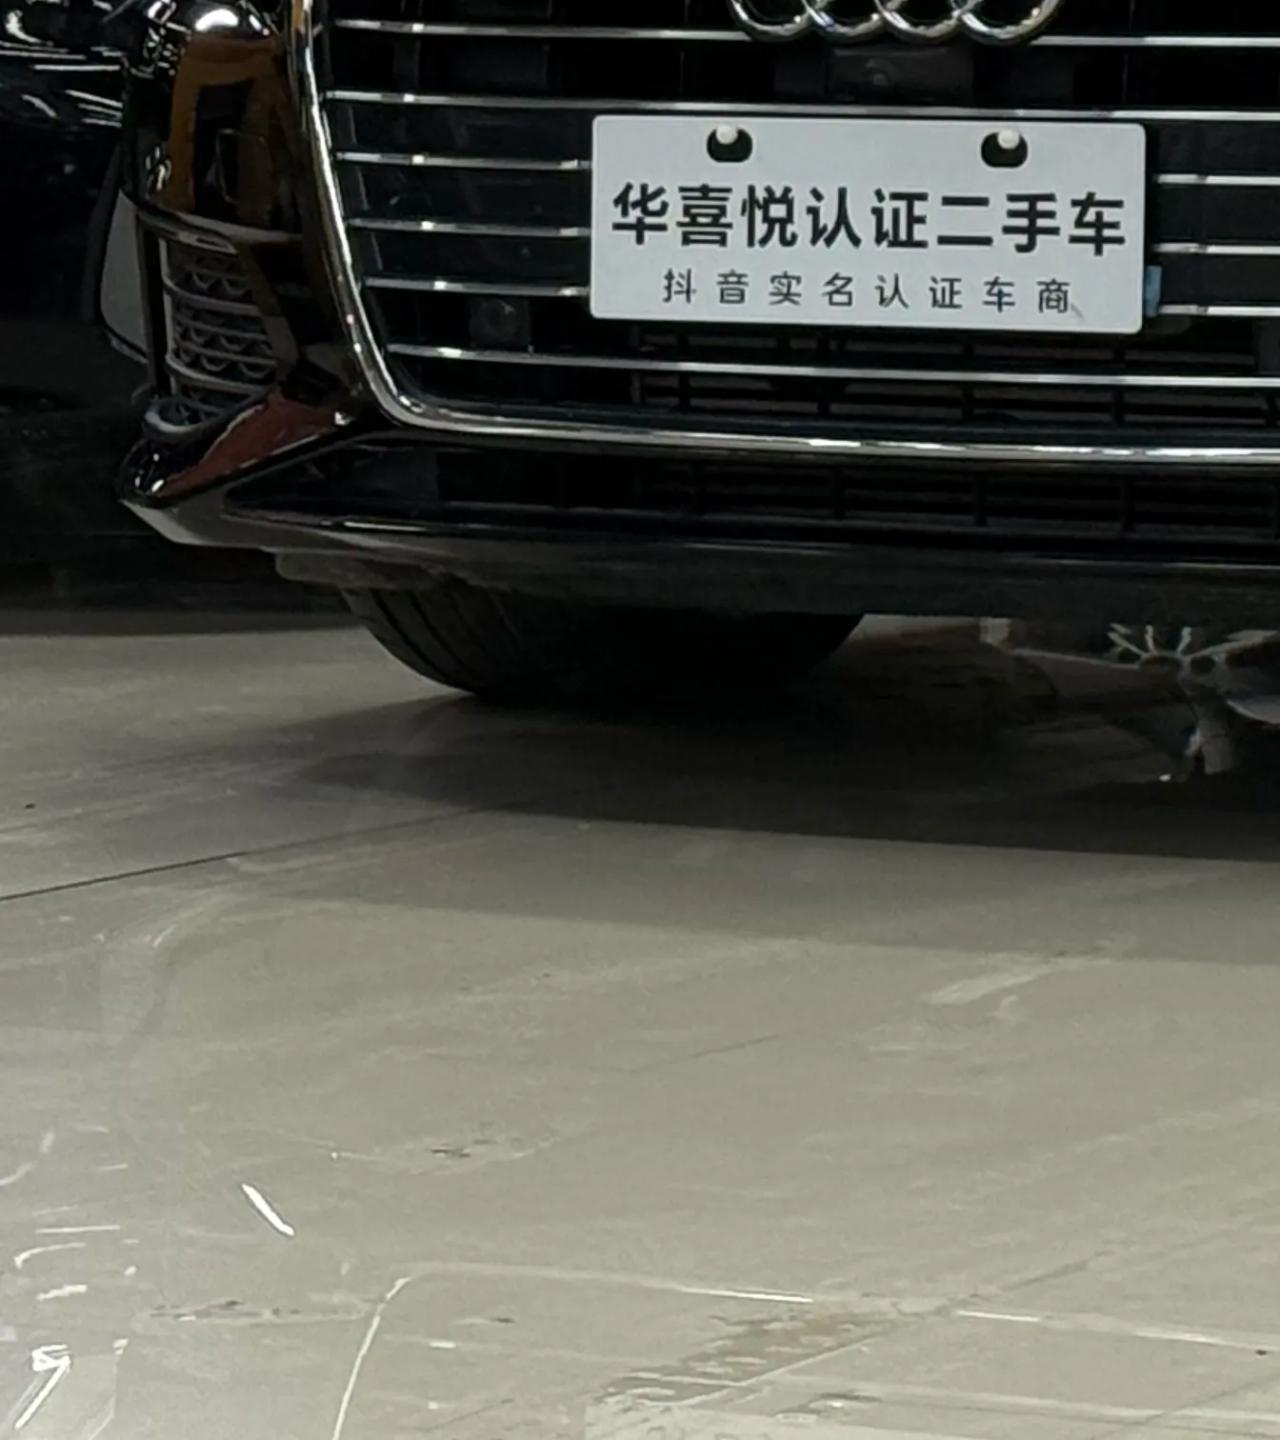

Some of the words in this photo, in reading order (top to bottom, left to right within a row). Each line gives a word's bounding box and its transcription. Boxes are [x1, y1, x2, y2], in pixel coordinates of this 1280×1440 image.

[611, 181, 1127, 257] 华喜悦认证二手车
[661, 267, 1073, 315] 抖音实名认证车商
